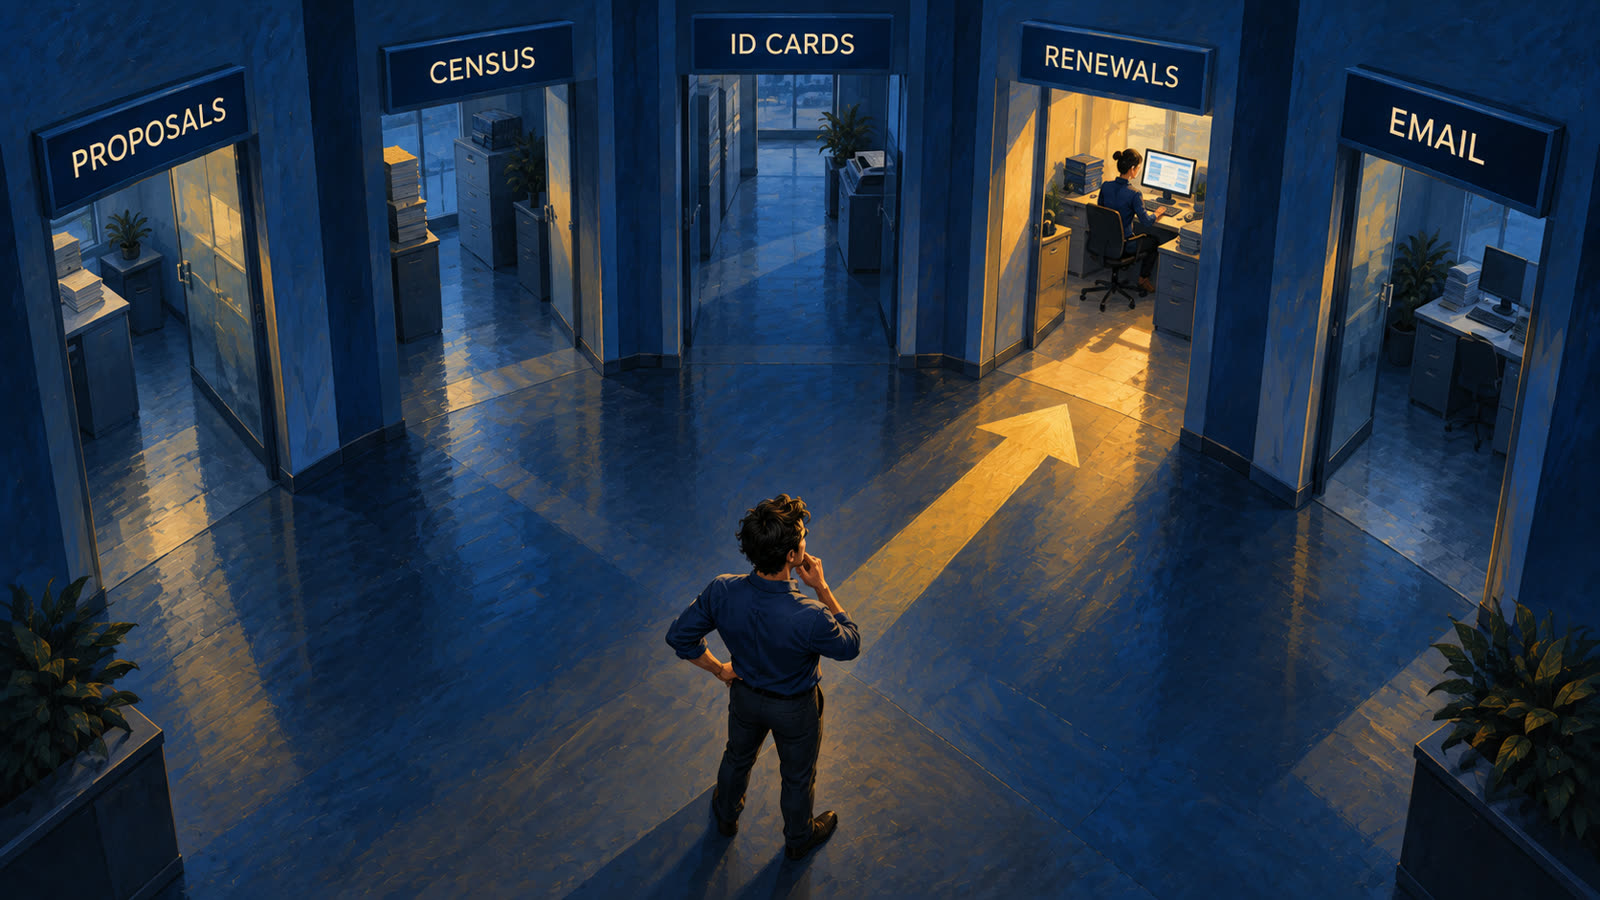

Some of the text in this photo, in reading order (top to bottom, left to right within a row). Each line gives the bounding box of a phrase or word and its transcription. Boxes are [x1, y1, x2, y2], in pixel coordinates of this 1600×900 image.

[429, 46, 536, 84] CENSUS
[731, 33, 855, 55] ID CARDS
[1043, 45, 1180, 89] RENEWALS
[72, 97, 227, 179] PROPOSALS
[1388, 106, 1485, 166] EMAIL
